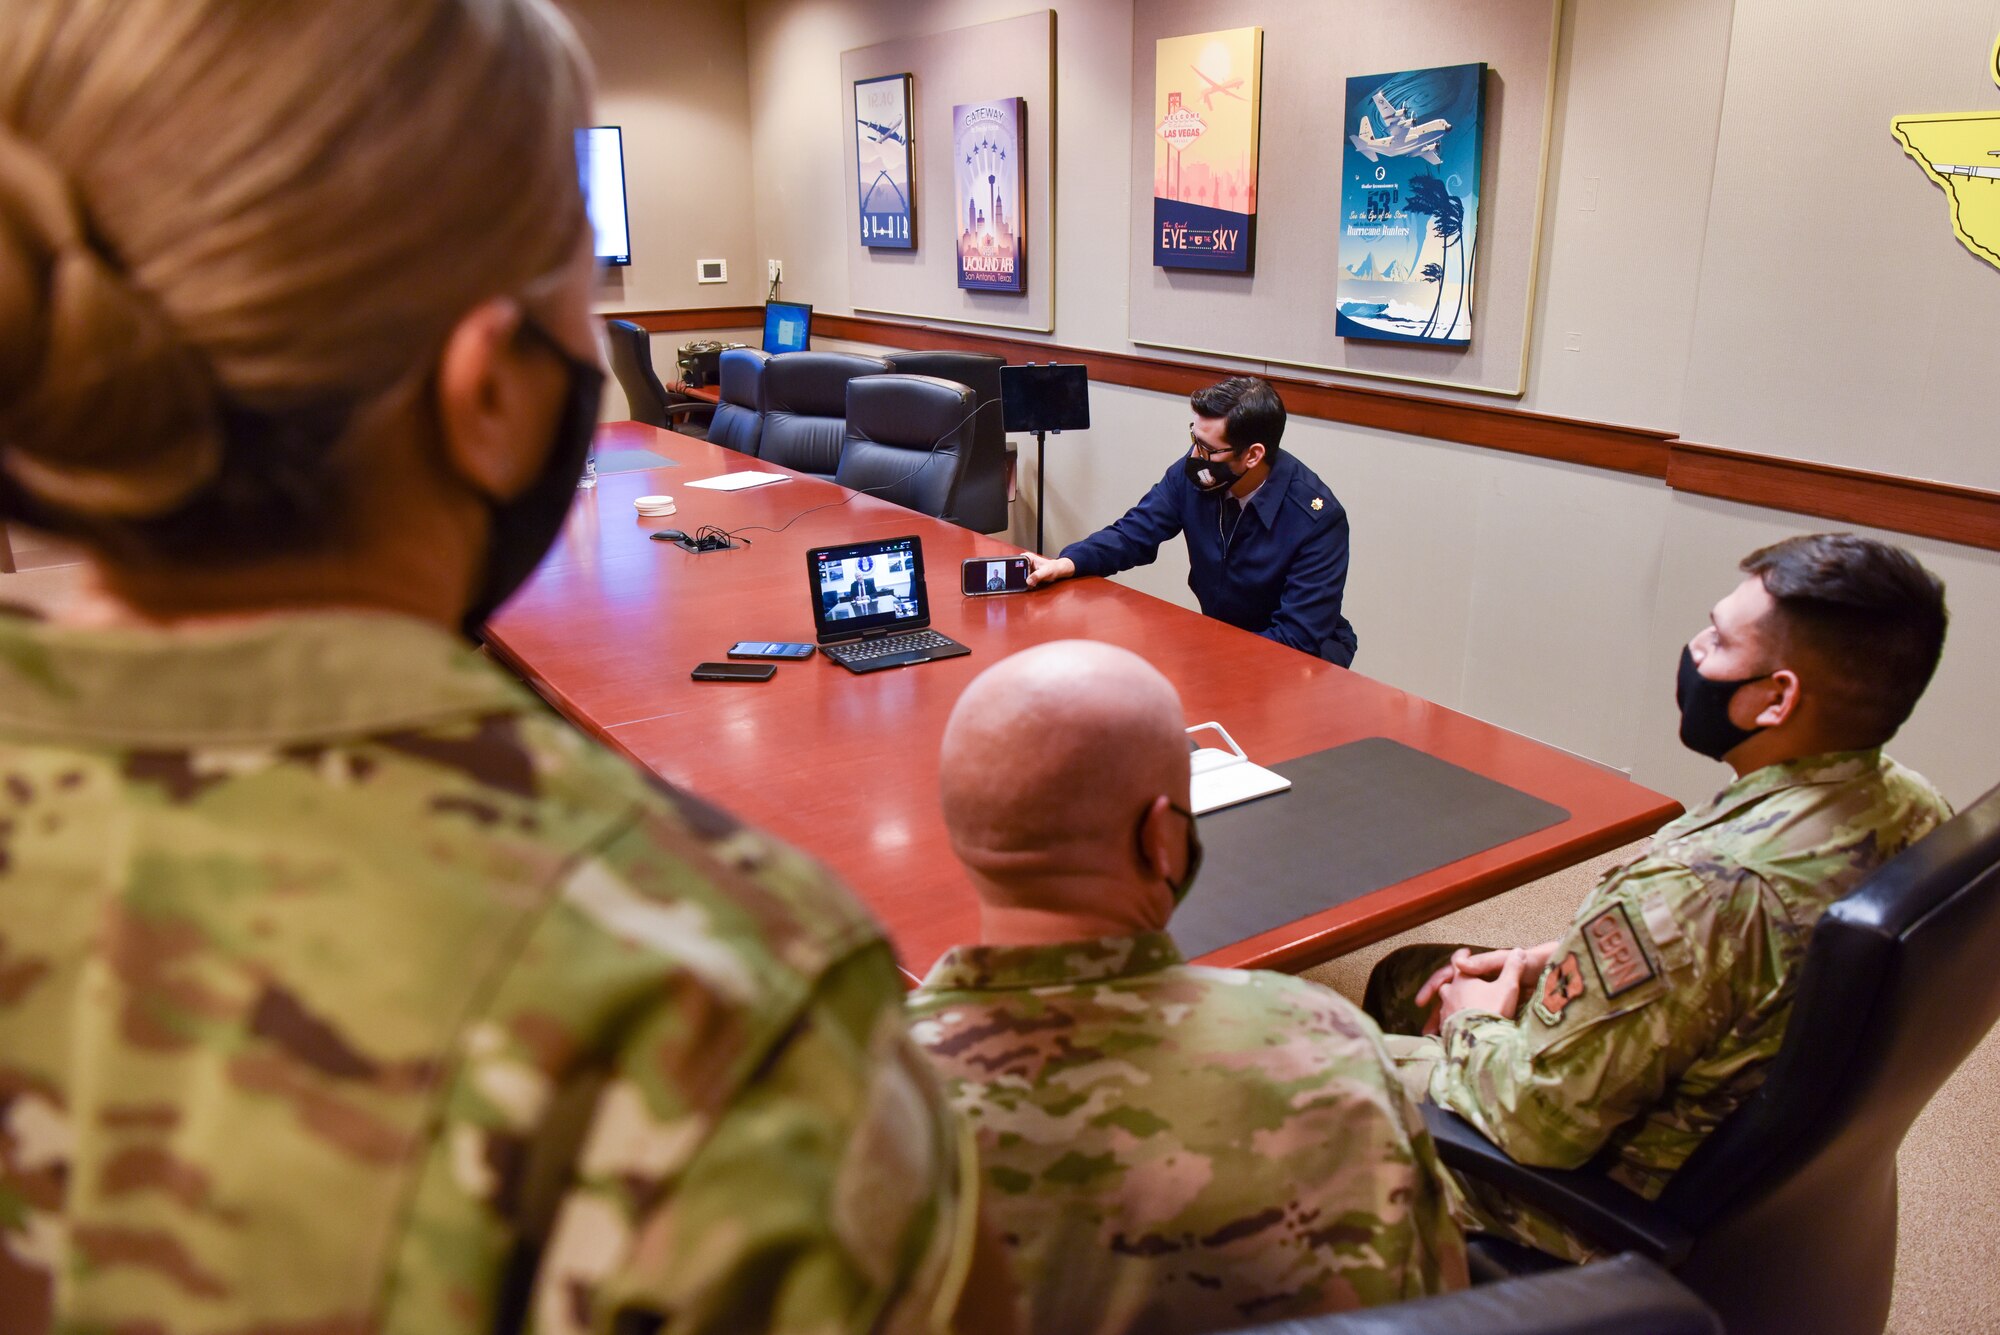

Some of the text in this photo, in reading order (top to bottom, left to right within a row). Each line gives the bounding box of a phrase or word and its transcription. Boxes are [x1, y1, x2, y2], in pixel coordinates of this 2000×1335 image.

[966, 108, 1004, 126] GATEWAY
[1164, 112, 1200, 121] WELCOME
[1164, 128, 1200, 138] LAS VEGAS
[1368, 210, 1377, 222] Eye
[1378, 209, 1385, 222] of
[1394, 209, 1408, 219] Storm
[863, 215, 909, 239] BY AIR
[1347, 224, 1381, 236] Hurricane
[1382, 224, 1410, 236] Hunters
[1162, 228, 1188, 249] EYE
[1212, 225, 1239, 251] SKY
[963, 255, 1014, 273] LACKLAND AFB
[965, 272, 975, 281] San
[998, 273, 1012, 283] Texas
[1592, 915, 1646, 989] CBRN
